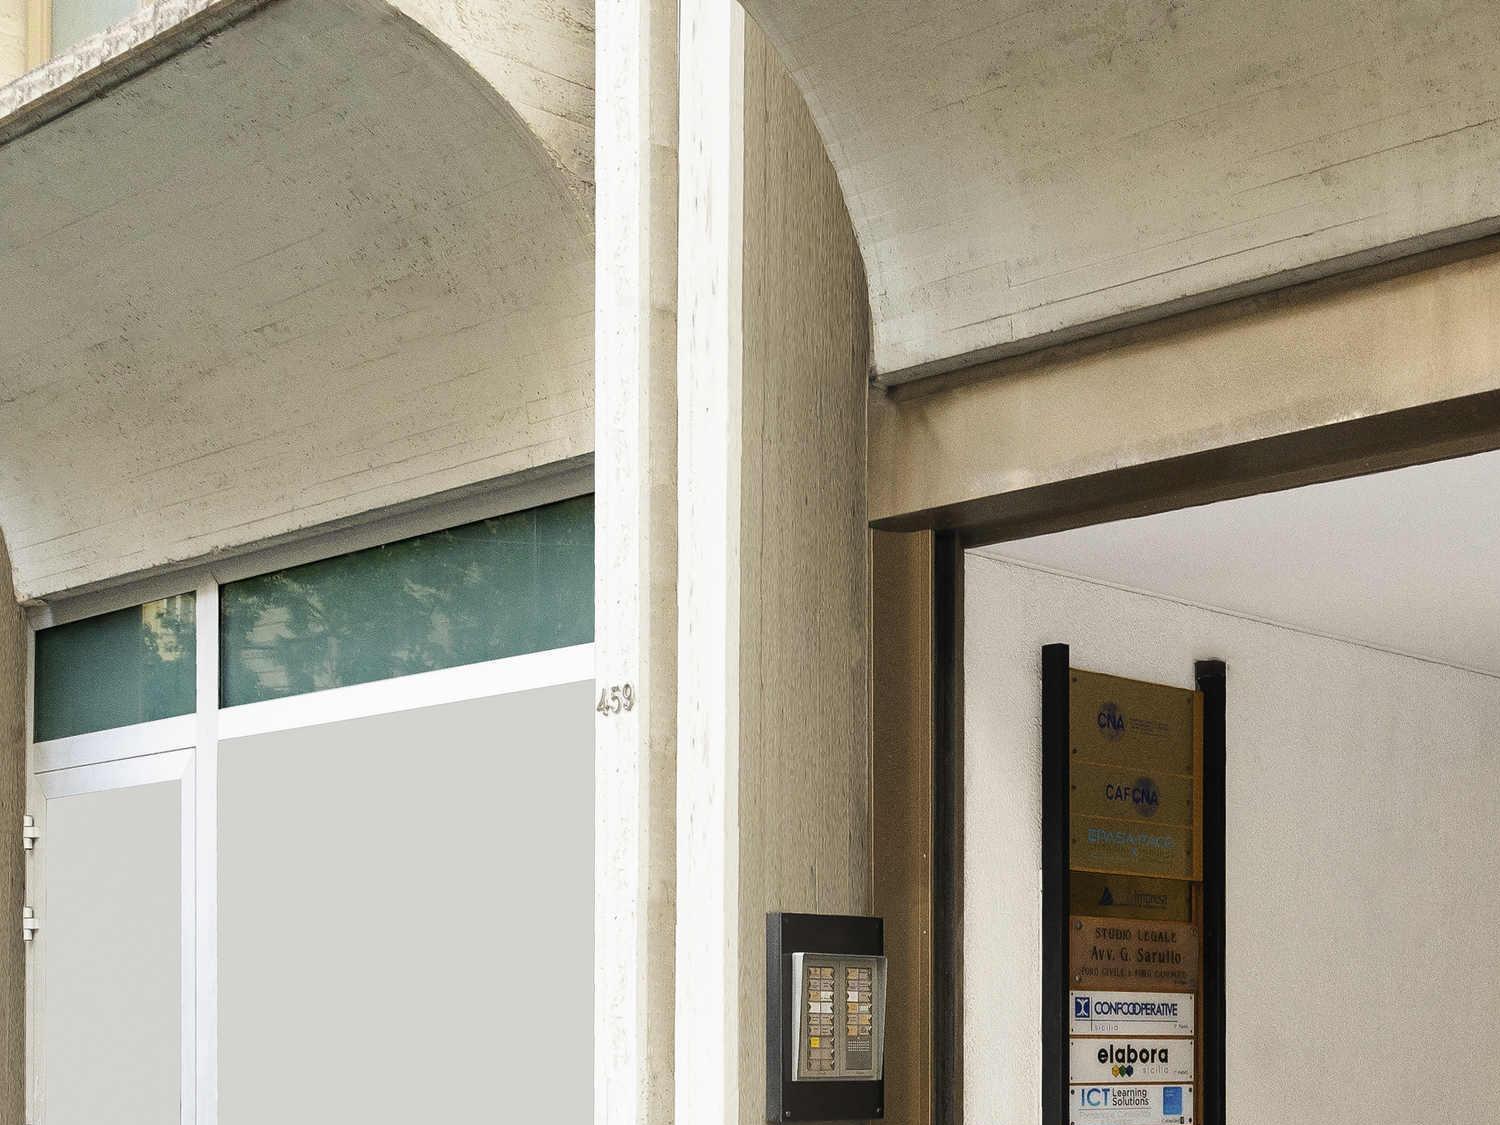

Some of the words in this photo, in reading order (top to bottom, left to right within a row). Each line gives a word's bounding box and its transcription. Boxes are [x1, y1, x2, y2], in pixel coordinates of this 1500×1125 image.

[597, 684, 634, 716] 459
[1098, 713, 1125, 731] CNA
[1095, 927, 1131, 942] STUDIO
[1138, 929, 1177, 944] LEGALE
[1091, 946, 1116, 961] Avv.
[1094, 1001, 1178, 1016] CONFCOOPERATIVE
[1097, 1044, 1169, 1063] elabora
[1081, 1088, 1110, 1107] ICT
[1112, 1088, 1147, 1098] Learning
[1112, 1097, 1149, 1107] Solutions
